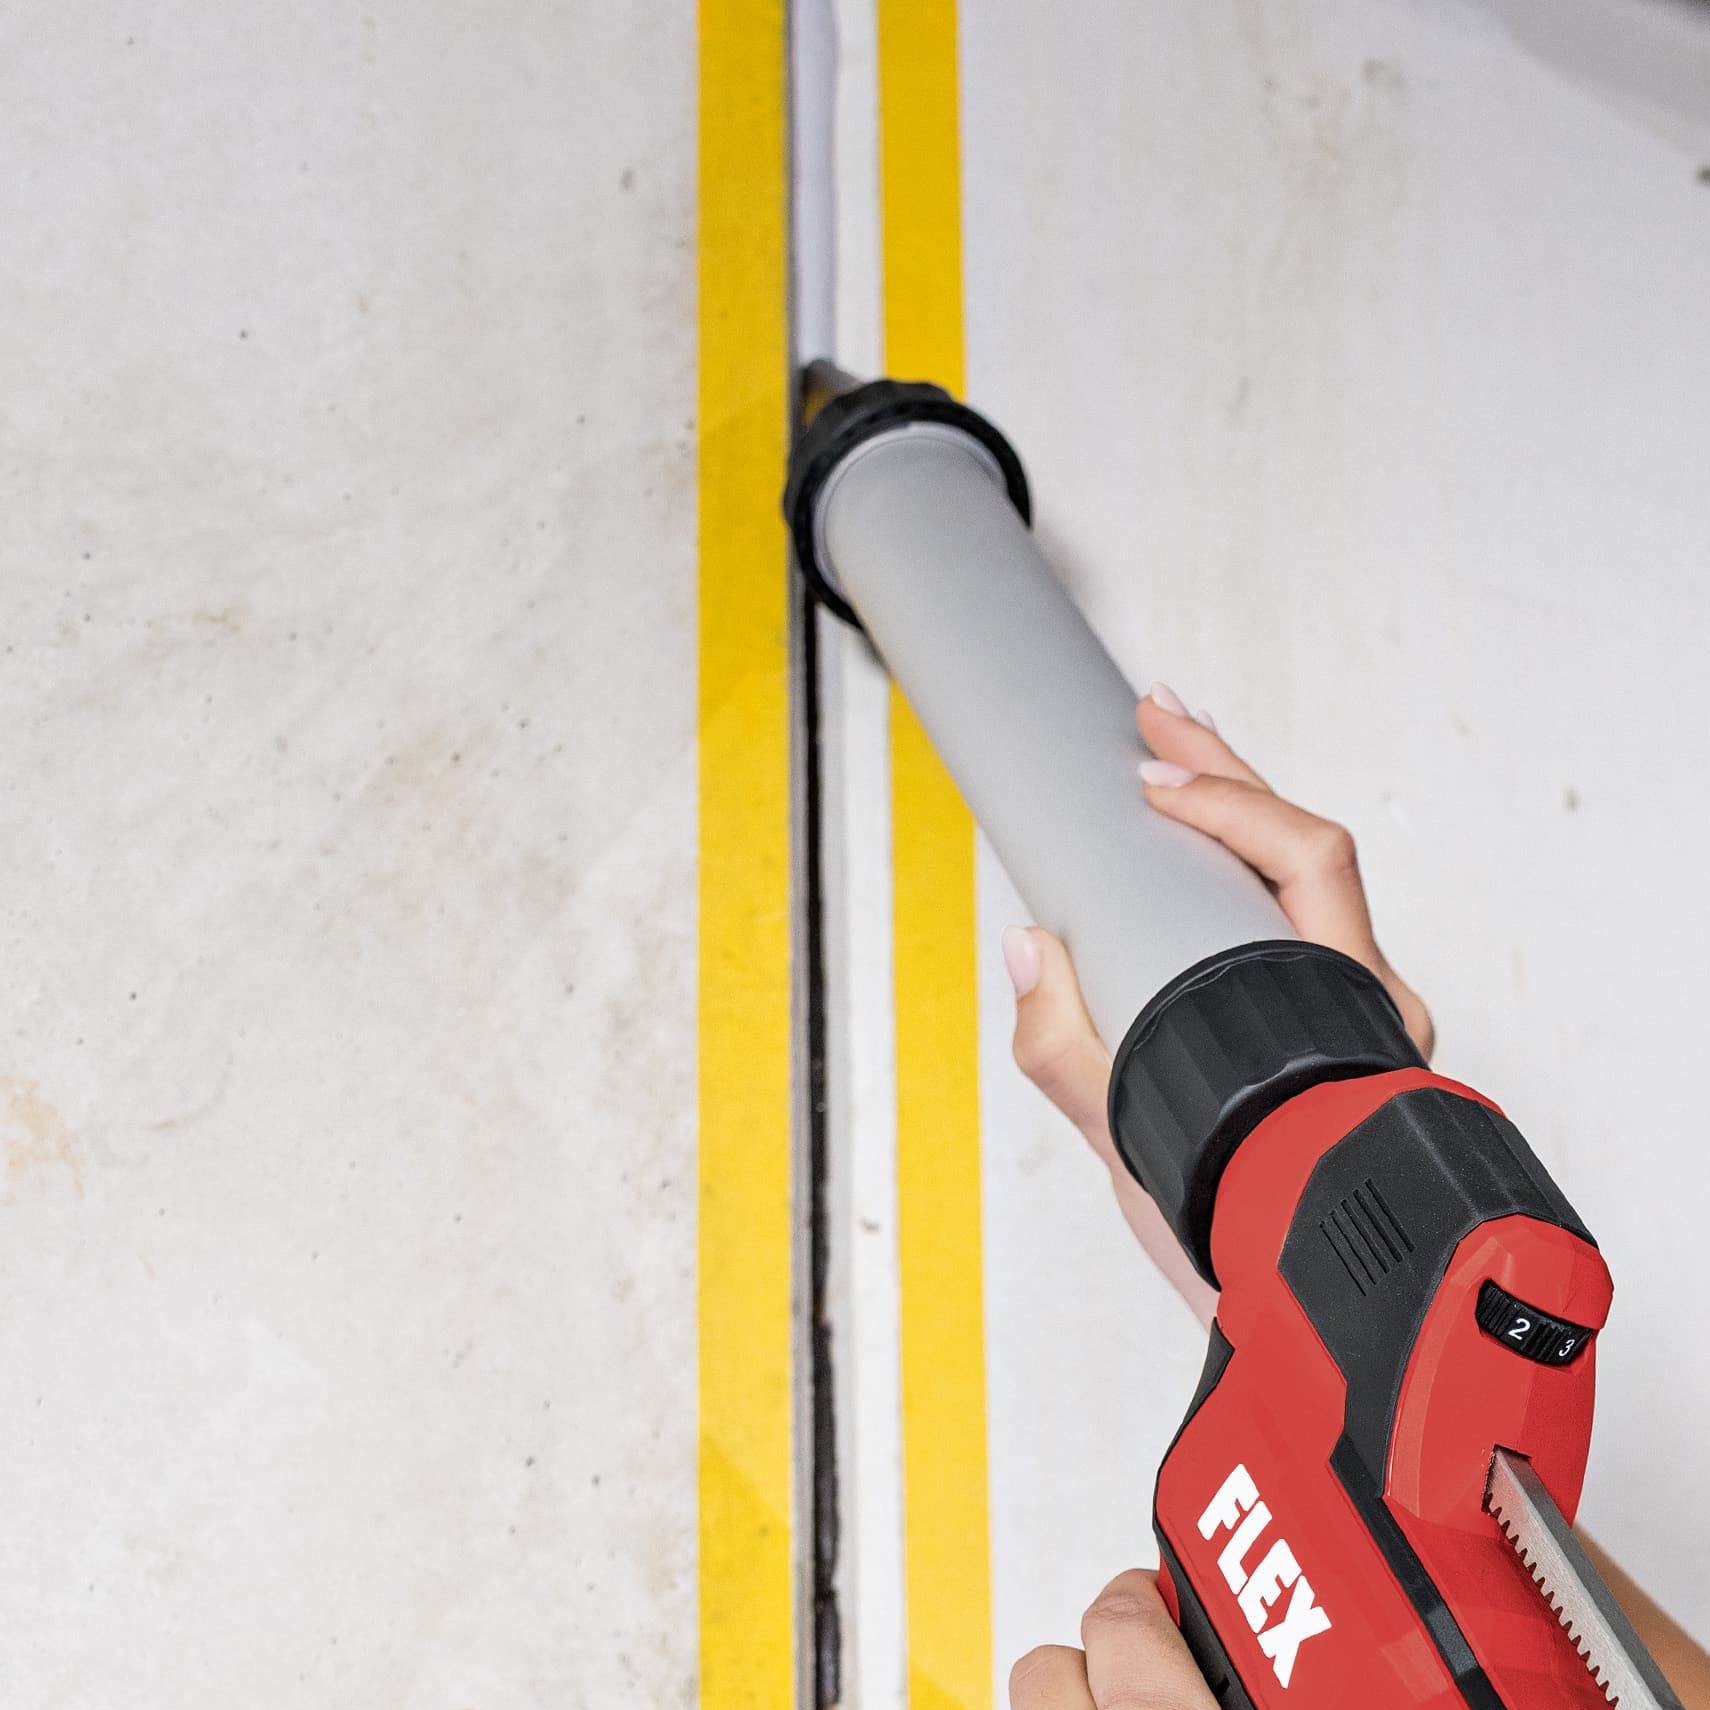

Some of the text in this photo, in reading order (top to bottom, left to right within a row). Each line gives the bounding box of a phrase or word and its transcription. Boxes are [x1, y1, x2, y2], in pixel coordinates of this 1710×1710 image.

[1507, 1318, 1531, 1341] 2
[1558, 1339, 1575, 1357] 3
[1197, 1463, 1332, 1689] FLEX
